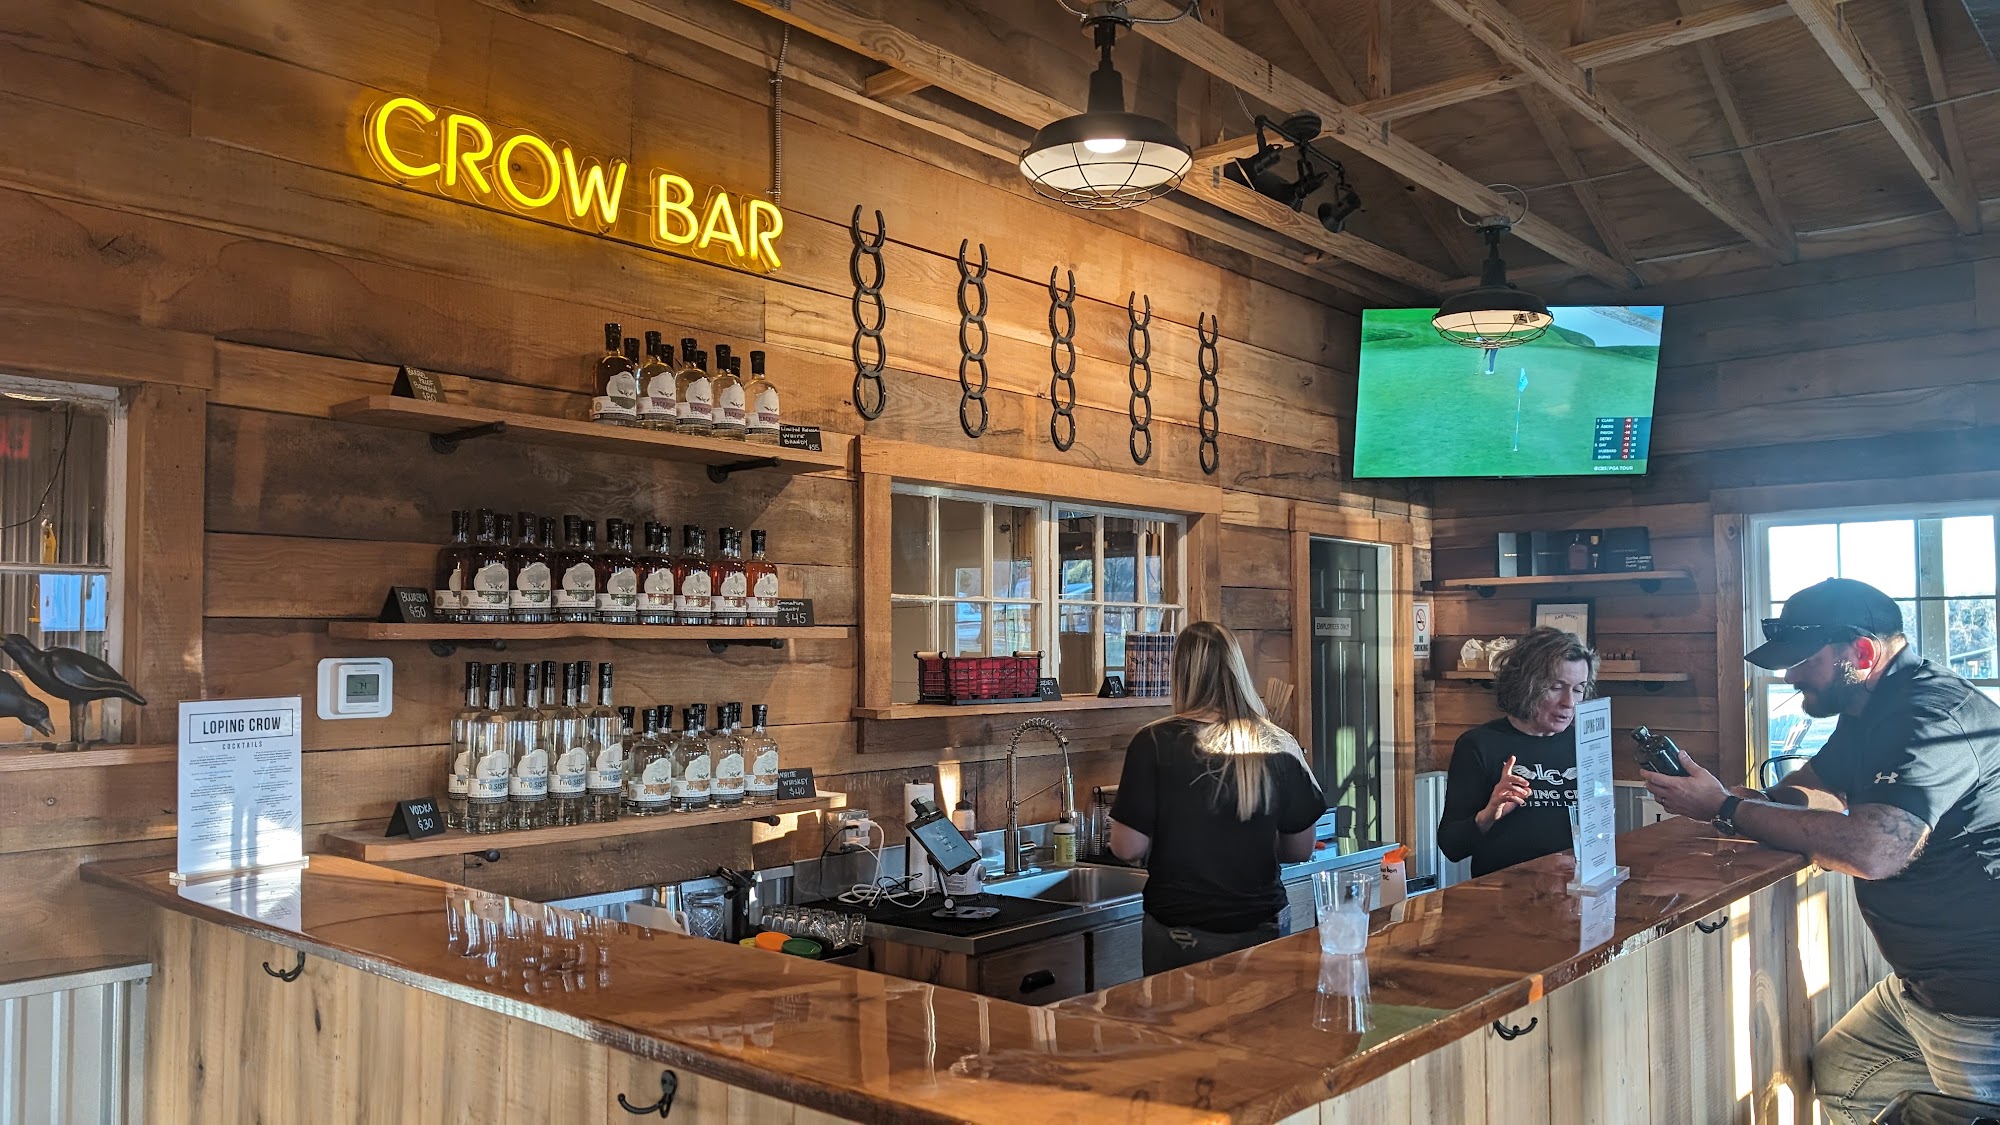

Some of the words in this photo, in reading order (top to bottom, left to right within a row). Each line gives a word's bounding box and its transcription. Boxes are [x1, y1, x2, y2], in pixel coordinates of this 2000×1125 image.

[375, 97, 628, 225] CROW
[657, 173, 784, 269] BAR
[408, 603, 426, 618] $50
[785, 612, 807, 625] $45
[202, 718, 245, 735] LOPING
[249, 716, 282, 732] CROW
[222, 740, 263, 750] COCKTAILS
[782, 777, 808, 787] WHISKEY
[788, 786, 806, 797] $40
[408, 802, 433, 816] VODKA
[417, 816, 434, 831] $30
